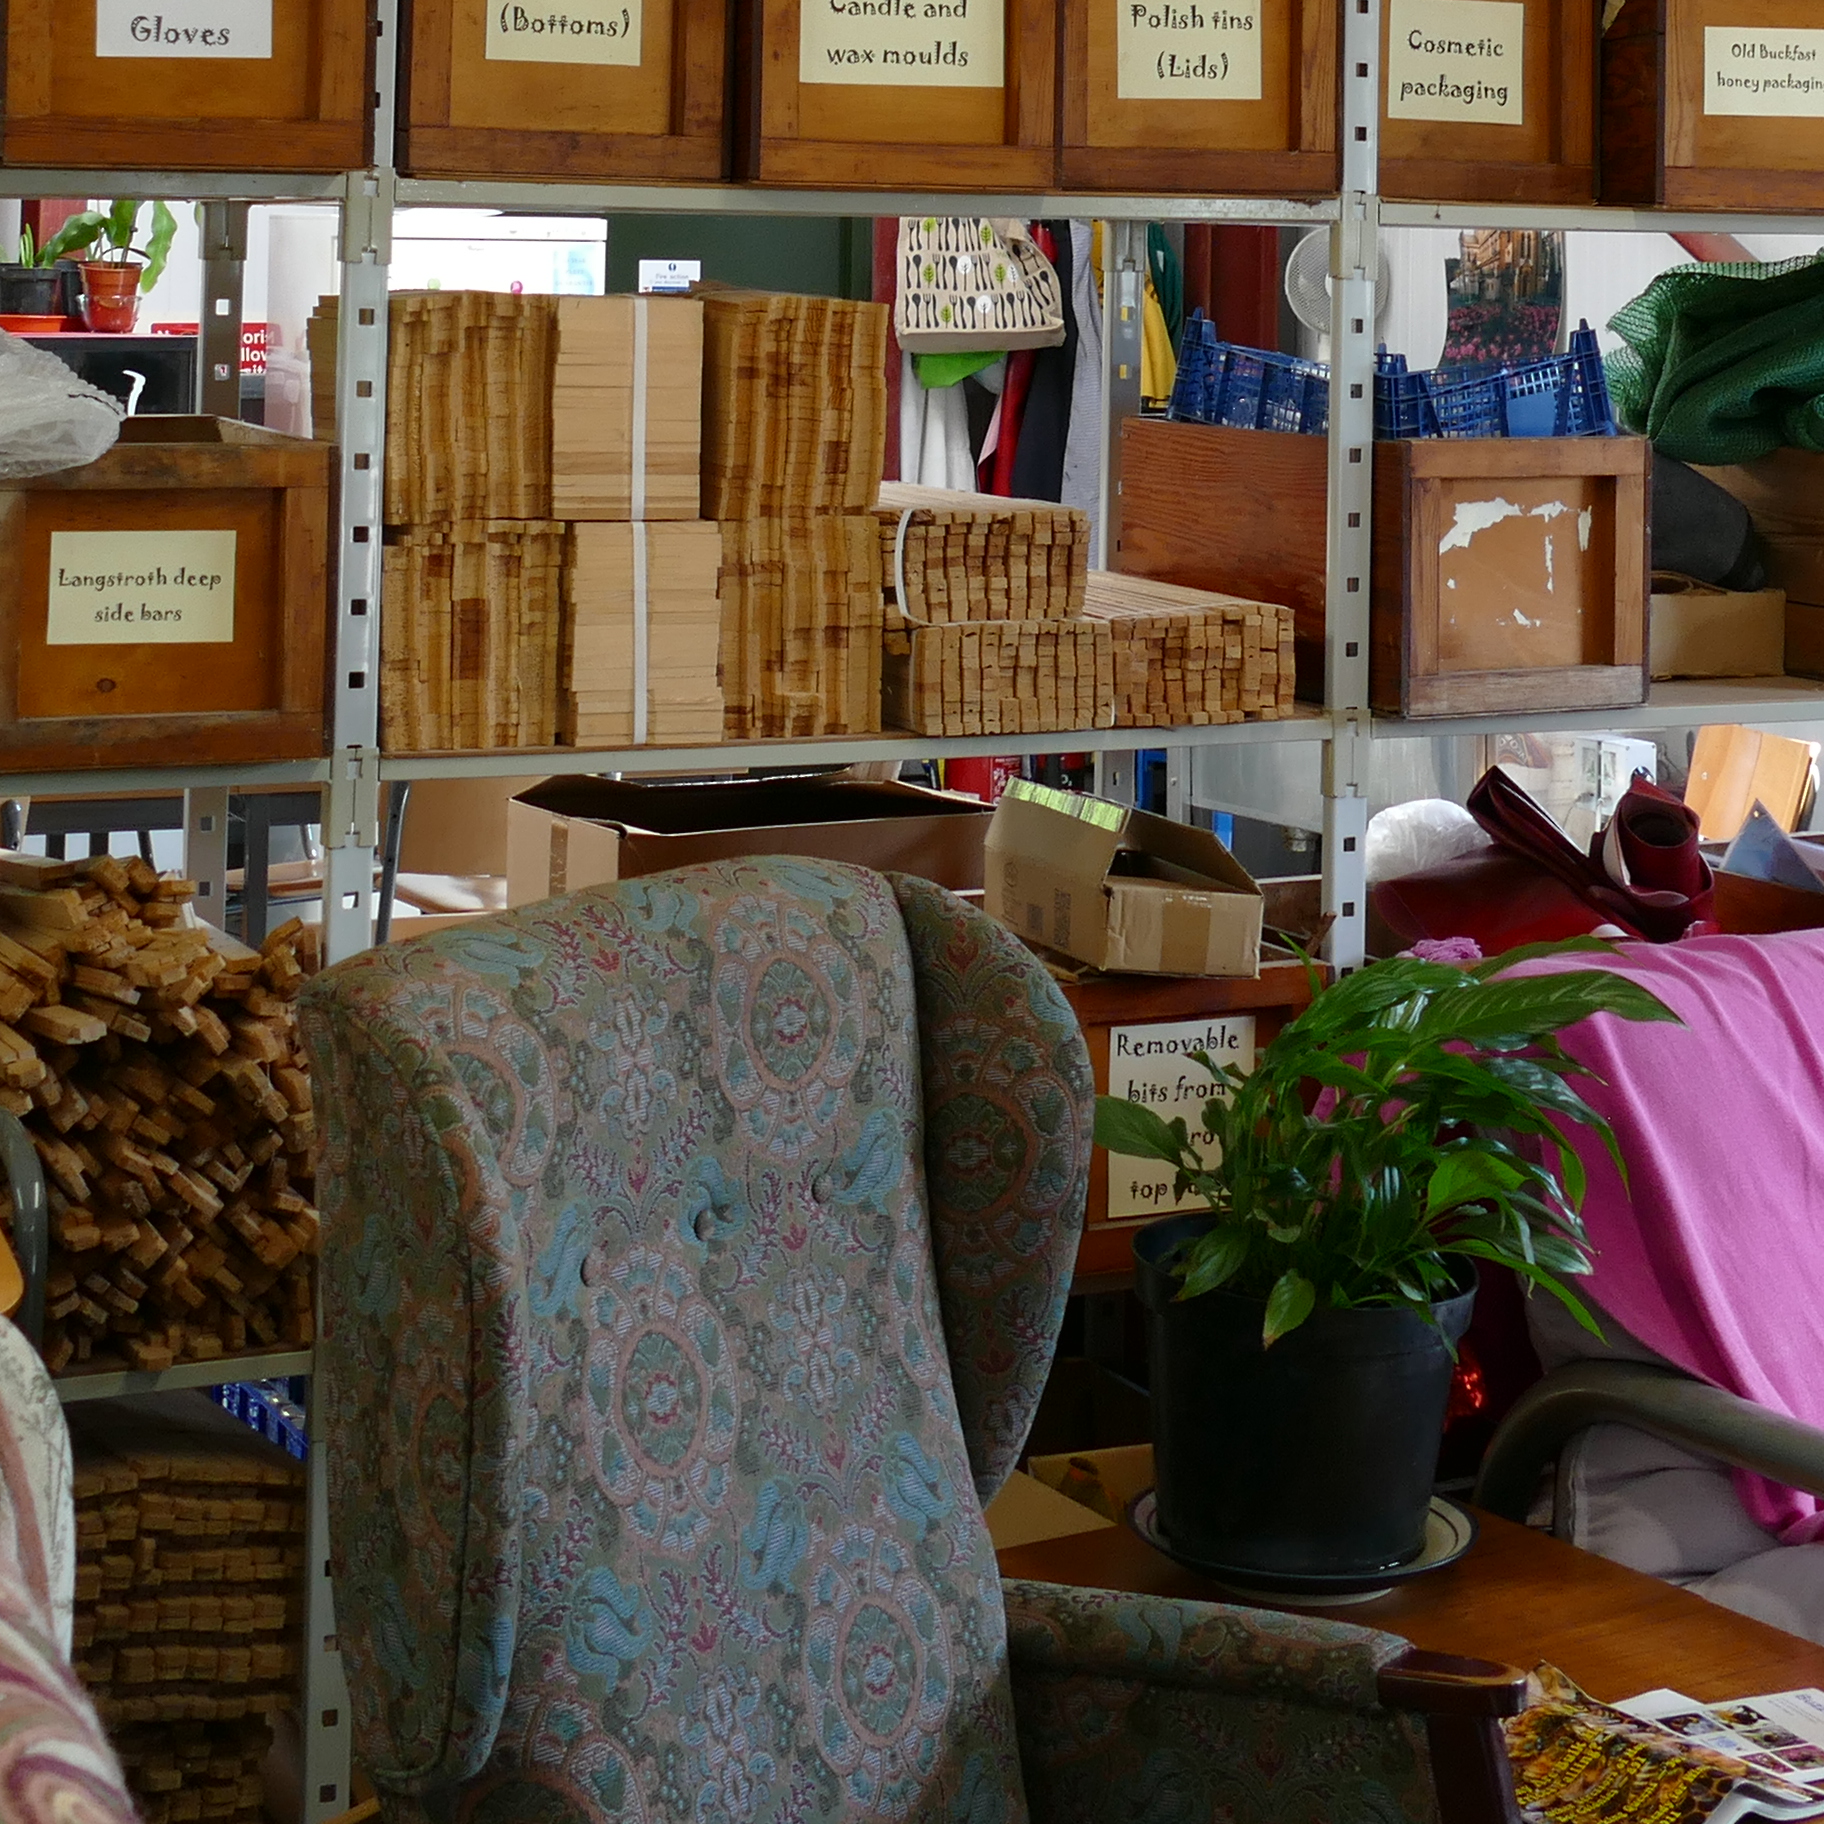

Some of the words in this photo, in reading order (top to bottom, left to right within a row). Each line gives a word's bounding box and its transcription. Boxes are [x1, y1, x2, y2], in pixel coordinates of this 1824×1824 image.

[130, 15, 230, 47] Gloves
[500, 3, 631, 38] (Bottoms)
[1131, 4, 1205, 30] Polish
[1212, 11, 1254, 31] tins
[827, 46, 875, 66] wax
[882, 41, 969, 67] moulds
[1407, 29, 1504, 57] Cosmetic
[1730, 43, 1756, 60] Old
[1759, 44, 1817, 61] Buckfast
[1156, 51, 1229, 79] (Lids)
[1400, 74, 1508, 106] packaging
[1717, 72, 1759, 92] honey
[58, 567, 168, 590] Langstroth
[173, 568, 222, 591] deep
[94, 604, 134, 623] side
[141, 603, 182, 623] bars
[1116, 1026, 1240, 1058] Removable
[1127, 1081, 1168, 1103] bits
[1174, 1079, 1227, 1103] from
[1130, 1178, 1168, 1203] top
[1554, 1737, 1587, 1772] Bulk
